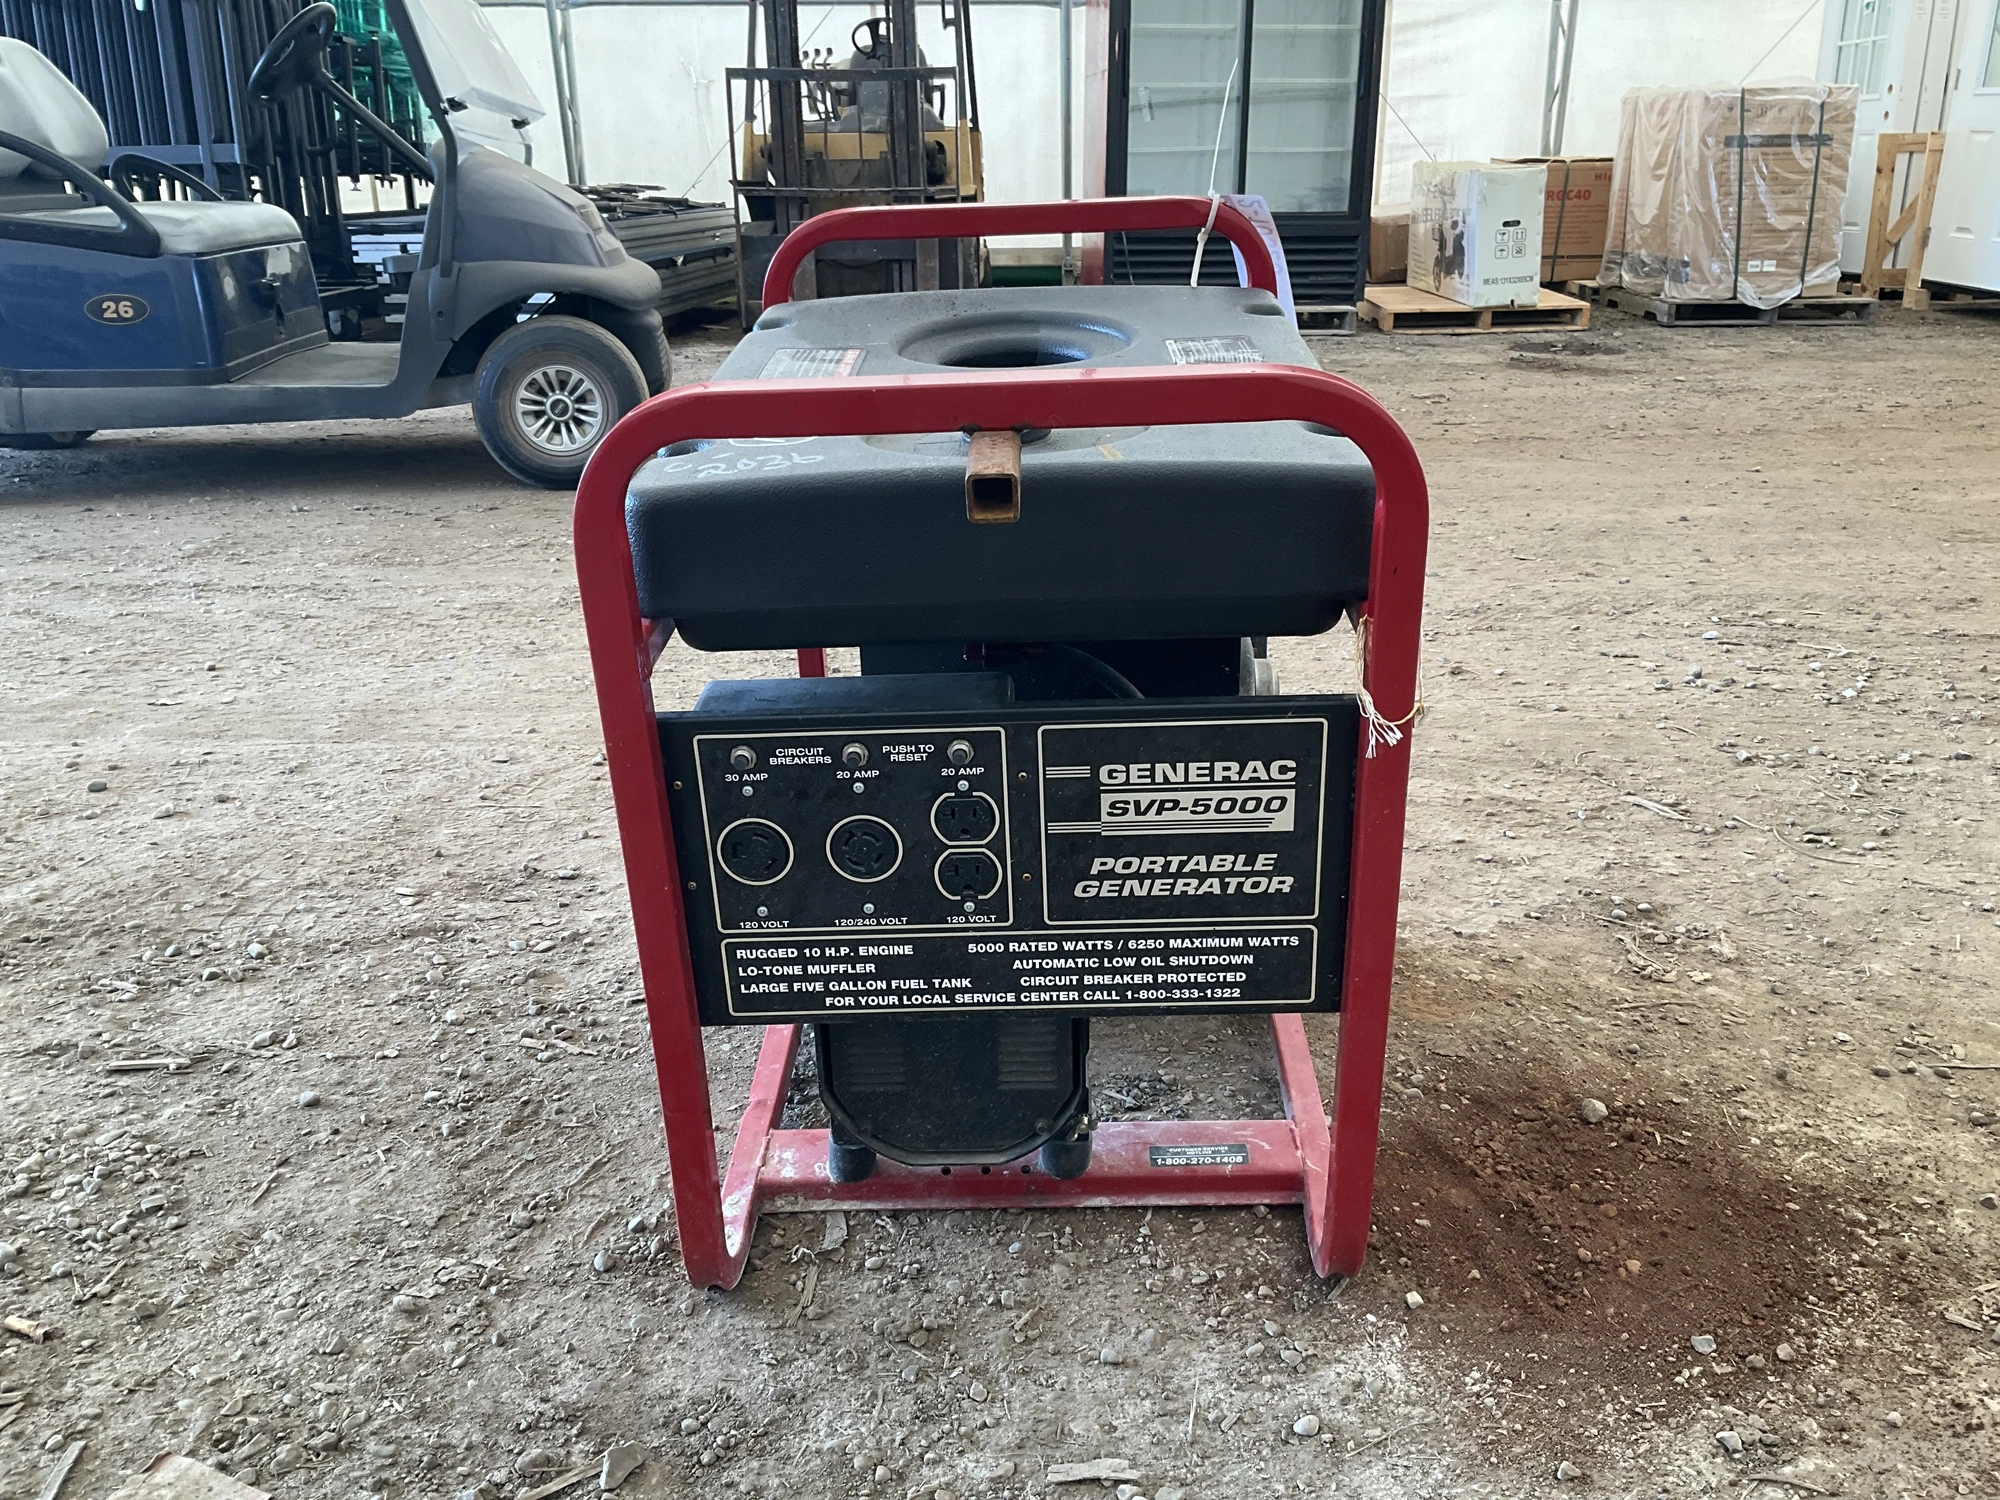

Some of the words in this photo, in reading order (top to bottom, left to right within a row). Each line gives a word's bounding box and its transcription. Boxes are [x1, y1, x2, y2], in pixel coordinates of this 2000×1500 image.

[102, 301, 134, 318] 26
[775, 747, 824, 757] CIRCUIT
[882, 745, 916, 754] PUSH
[918, 744, 935, 753] TO
[769, 756, 832, 765] BREAKERS
[890, 753, 928, 762] RESET
[725, 773, 740, 782] 30
[742, 773, 768, 781] AMP
[836, 771, 851, 779] 20
[853, 770, 880, 778] AMP
[941, 768, 956, 776] 20
[957, 767, 985, 775] AMP
[1098, 759, 1297, 785] GENERAC
[1106, 795, 1288, 817] SVP-5000
[1089, 853, 1278, 875] PORTABLE
[1073, 876, 1295, 898] GENERATOR
[739, 921, 759, 929] 120
[760, 920, 790, 928] VOLT
[834, 918, 877, 927] 120/240
[878, 917, 908, 925] VOLT
[946, 915, 966, 924] 120
[967, 915, 997, 923] VOLT
[736, 948, 798, 959] RUGGED
[803, 947, 821, 958] 10
[825, 946, 855, 957] H.P.
[858, 945, 914, 956] ENGINE
[967, 943, 1004, 954] 5000
[1009, 941, 1058, 953] RATED
[1062, 940, 1114, 951] WATTS
[1117, 939, 1124, 950] /
[1127, 938, 1165, 950] 6250
[1169, 937, 1244, 949] MAXIMUM
[1247, 936, 1300, 947] WATTS
[1012, 957, 1100, 970] AUTOMATIC
[1103, 956, 1137, 968] LOW
[1140, 956, 1165, 967] OIL
[1169, 954, 1254, 966] SHUTDOWN
[738, 965, 803, 977] LO-TONE
[807, 963, 876, 975] MUFFLER
[740, 982, 789, 994] LARGE
[792, 981, 825, 992] FIVE
[828, 980, 887, 991] GALLON
[891, 979, 928, 990] FUEL
[932, 978, 972, 989] TANK
[1020, 975, 1081, 987] CIRCUIT
[1083, 973, 1154, 985] BREAKER
[1157, 972, 1247, 984] PROTECTED
[825, 996, 855, 1007] FOR
[858, 995, 899, 1006] YOUR
[903, 994, 950, 1005] LOCAL
[954, 992, 1016, 1004] SERVICE
[1020, 991, 1080, 1003] CENTER
[1083, 990, 1120, 1001] CALL
[1125, 988, 1241, 1000] 1-800-333-1322
[1157, 1156, 1243, 1165] 1-800-270-1408
